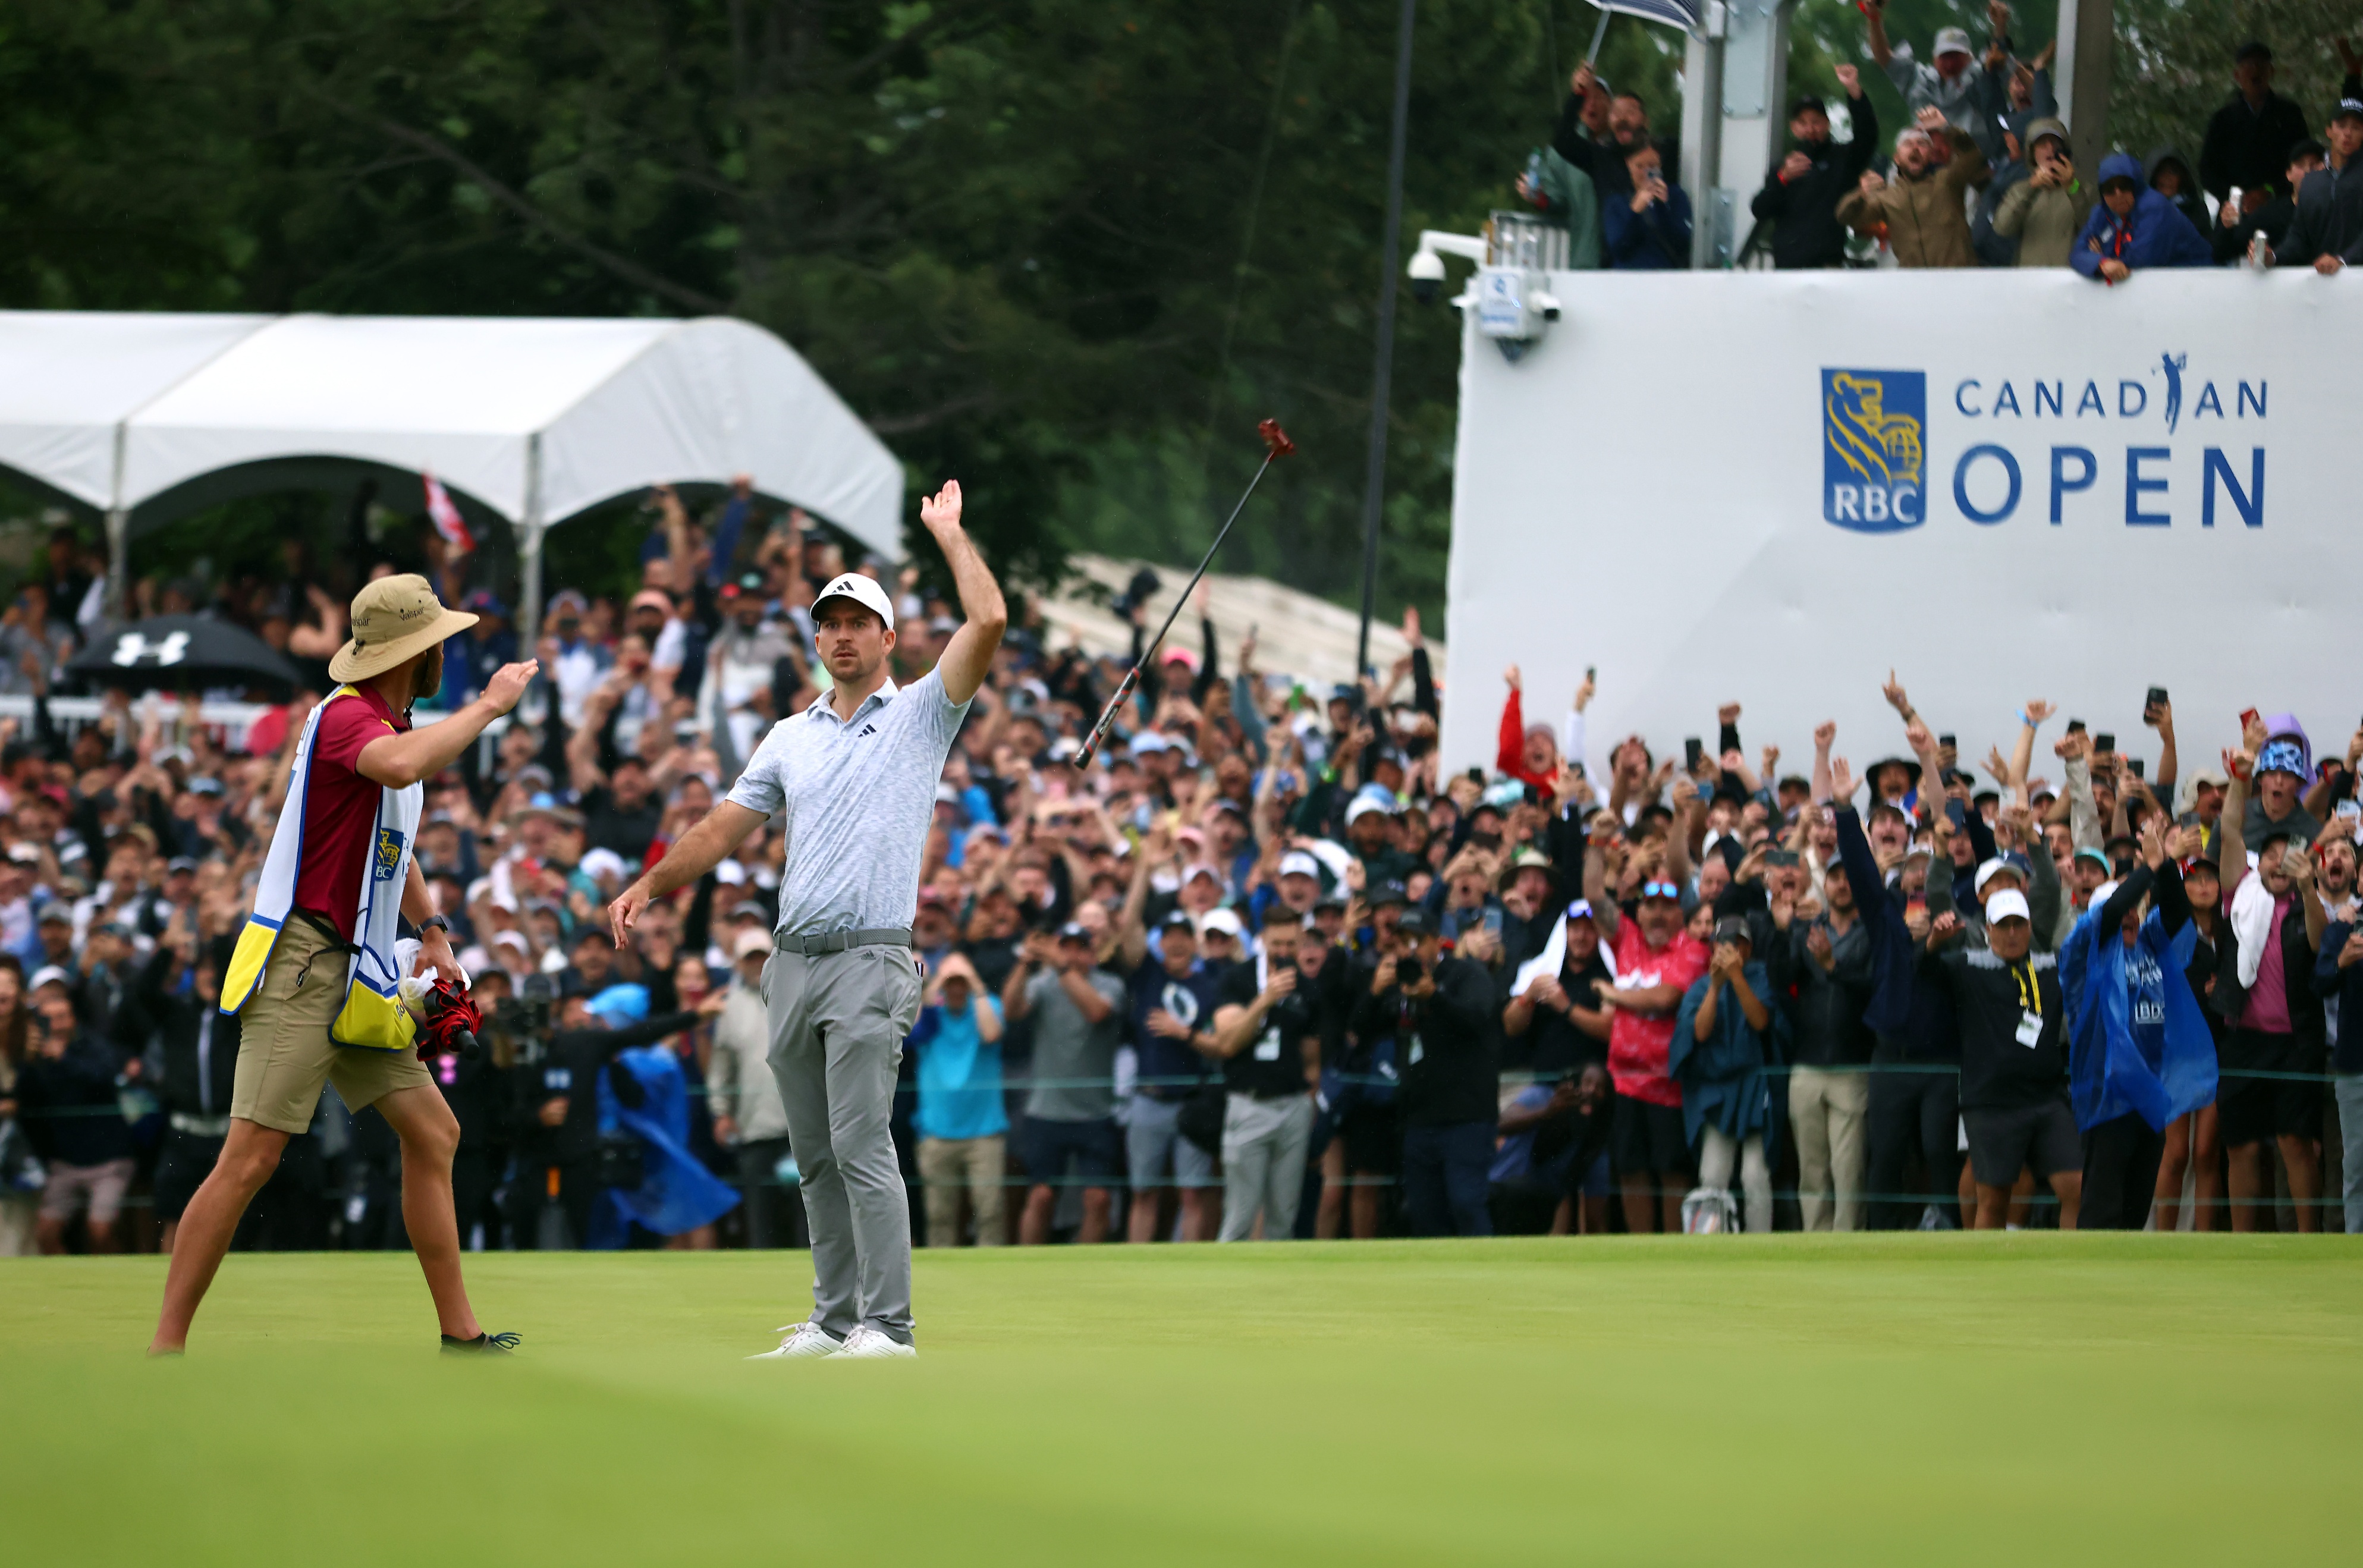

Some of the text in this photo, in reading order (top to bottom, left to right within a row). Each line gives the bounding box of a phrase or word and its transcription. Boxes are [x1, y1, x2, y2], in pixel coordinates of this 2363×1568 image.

[1953, 443, 2266, 529] OPEN
[1833, 483, 1918, 524] RBC
[399, 607, 425, 621] Valspar
[351, 616, 371, 629] alspar
[375, 865, 392, 879] BC
